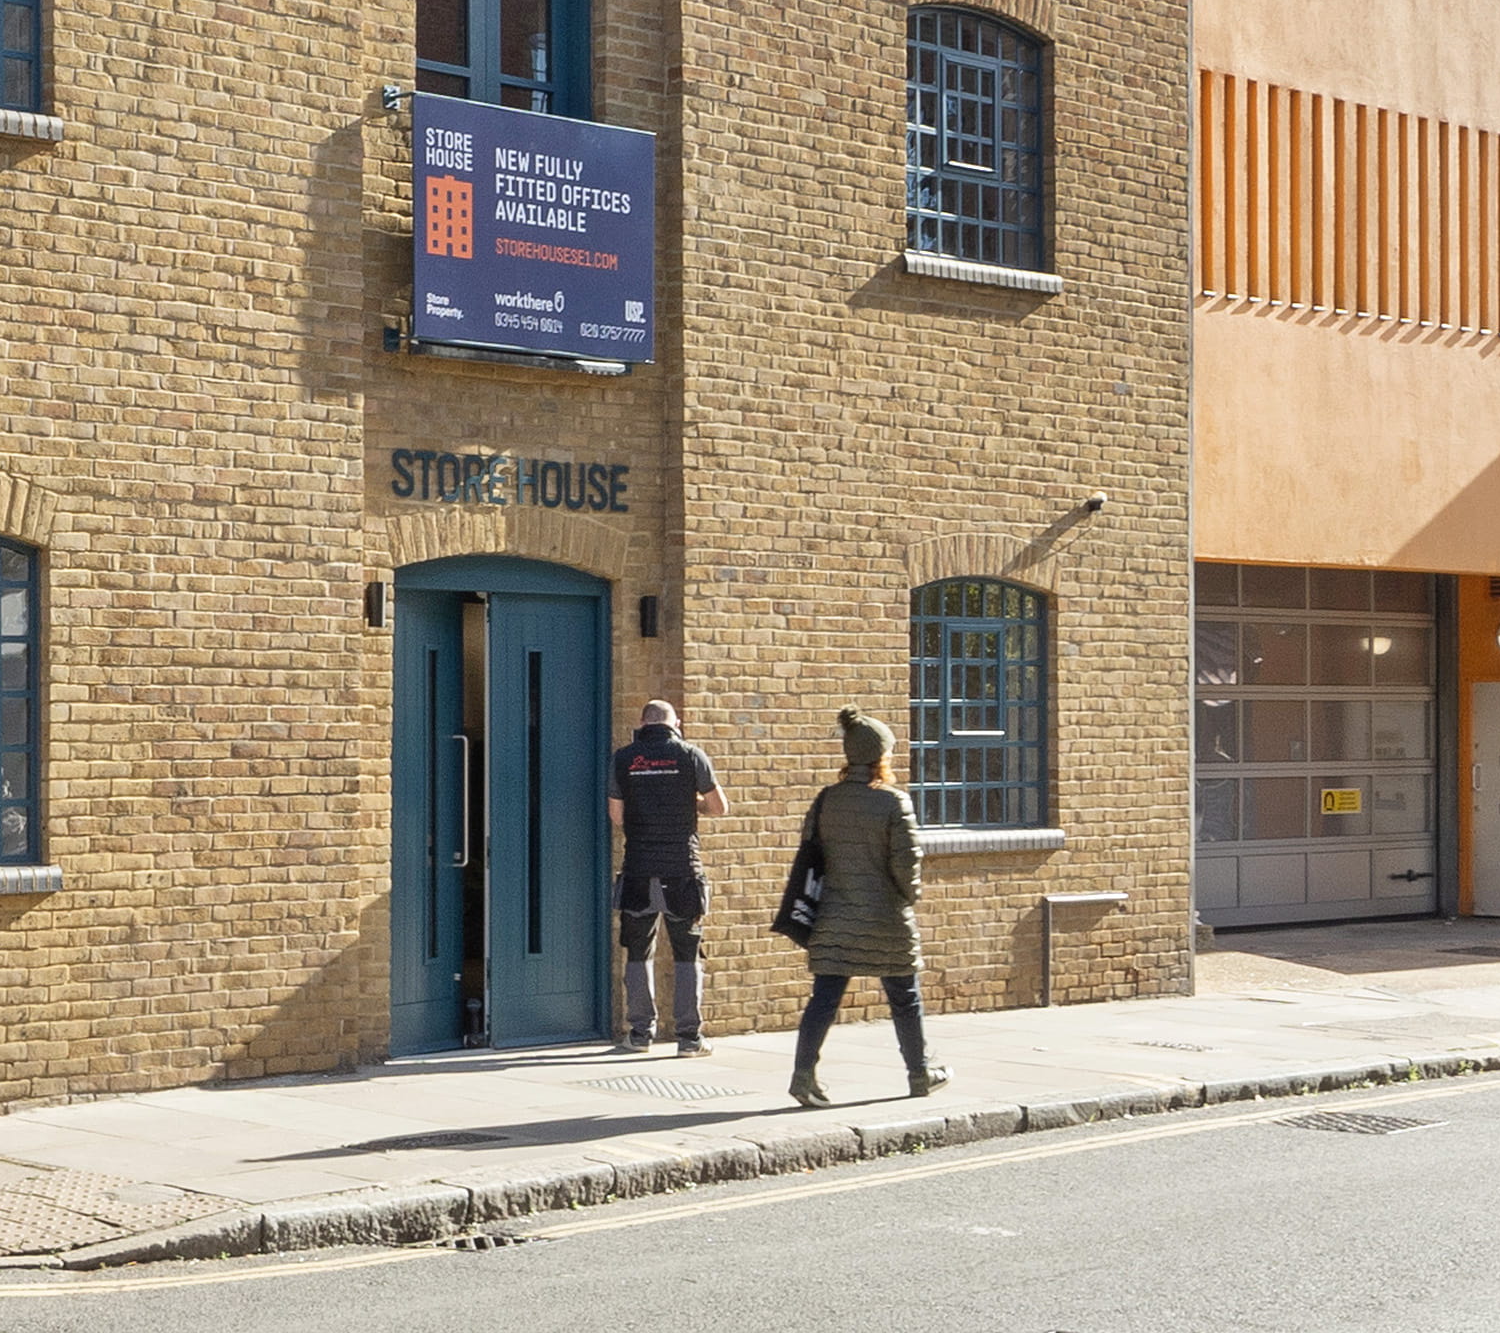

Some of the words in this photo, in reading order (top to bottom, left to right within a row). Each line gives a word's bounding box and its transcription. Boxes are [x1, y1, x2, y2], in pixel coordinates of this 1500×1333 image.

[425, 127, 473, 153] STORE
[425, 149, 473, 172] HOUSE
[495, 147, 530, 173] NEW
[535, 154, 584, 181] FULLY
[495, 173, 556, 202] FITTED
[562, 184, 632, 214] OFFICES
[495, 199, 587, 233] AVAILABLE
[495, 237, 619, 271] STOREHOUSESE1.COM
[426, 292, 450, 306] Store
[494, 290, 554, 312] workthere
